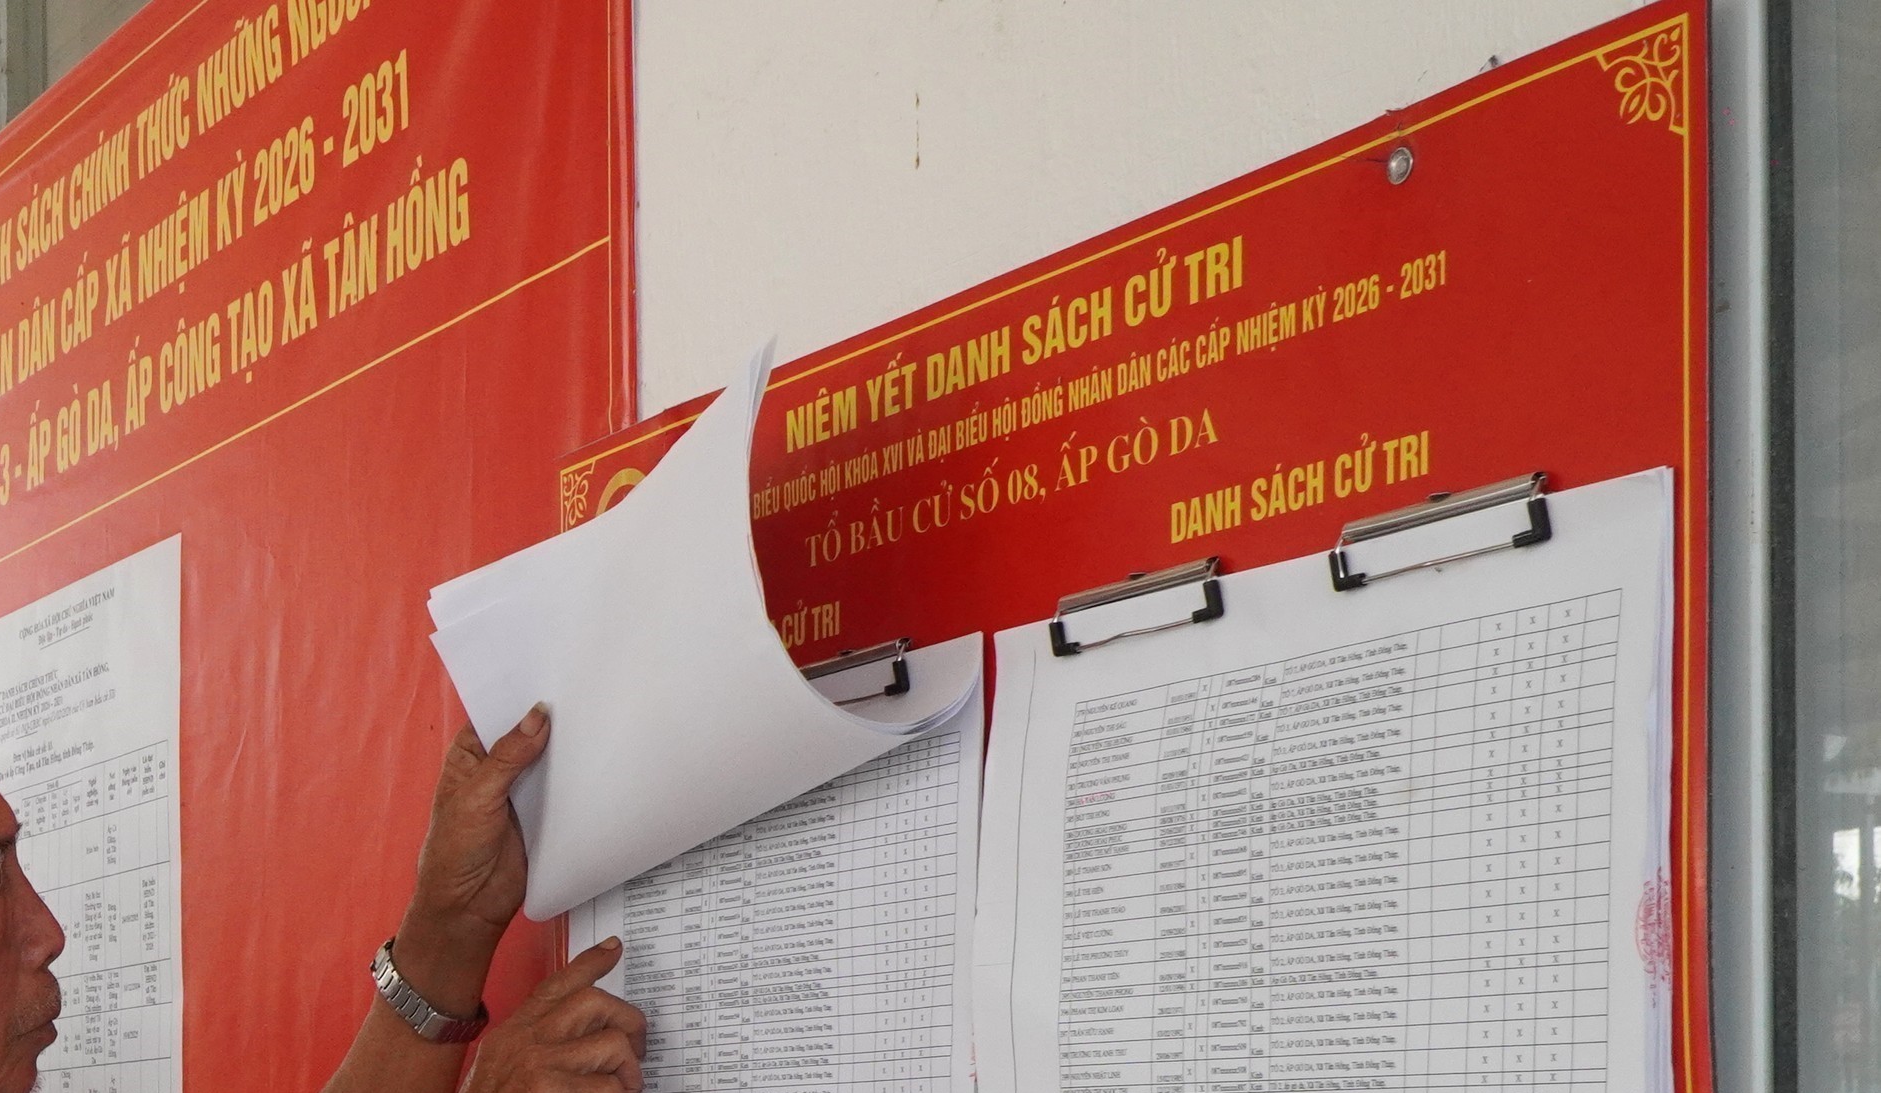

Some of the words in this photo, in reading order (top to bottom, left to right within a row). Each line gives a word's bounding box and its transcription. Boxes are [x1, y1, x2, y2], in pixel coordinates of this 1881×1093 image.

[15, 175, 65, 272] SÁCH
[70, 121, 130, 231] CHÍNH
[137, 73, 190, 180] THỨC
[197, 4, 283, 136] NHỮNG
[18, 295, 56, 384] DÂN
[60, 250, 99, 355] CẤP
[104, 230, 133, 327] XÃ
[137, 187, 209, 304] NHIỆM
[217, 149, 247, 252] KỲ
[253, 115, 315, 227] 2026
[323, 135, 334, 156] -
[342, 47, 409, 169] 2031
[0, 443, 10, 506] 3
[14, 463, 22, 479] -
[26, 399, 51, 492] ẤP
[56, 383, 81, 474] GÒ
[86, 379, 119, 452] DA,
[124, 335, 153, 436] ẤP
[159, 312, 221, 414] CÔNG
[227, 279, 274, 384] TẠO
[281, 237, 318, 347] XÃ
[323, 211, 378, 319] TÂN
[386, 154, 470, 285] HỒNG
[753, 476, 780, 521] BIỂU
[783, 464, 816, 511] QUỐC
[820, 460, 840, 500] HỘI
[844, 445, 878, 490] KHÓA
[882, 440, 903, 476] XVI
[906, 427, 925, 468] VÀ
[928, 425, 951, 464] ĐẠI
[955, 401, 988, 451] BIỂU
[992, 396, 1017, 441] HỘI
[1021, 377, 1064, 429] ĐỒNG
[1068, 365, 1112, 412] NHÂN
[1117, 352, 1151, 396] DÂN
[1156, 337, 1190, 383] CÁC
[1195, 316, 1230, 369] CẤP
[1236, 301, 1296, 352] NHIỆM
[1302, 285, 1326, 332] KỲ
[1332, 273, 1379, 323] 2026
[1386, 284, 1394, 293] -
[1400, 249, 1446, 299] 2031
[786, 386, 858, 453] NIÊM
[866, 352, 917, 423] YẾT
[926, 325, 1010, 401] DANH
[1022, 286, 1112, 366] SÁCH
[1124, 247, 1176, 327] CỬ
[1184, 234, 1243, 305] TRI
[805, 509, 841, 567] TỔ
[849, 496, 904, 555] BẦU
[912, 479, 954, 534] CỬ
[959, 457, 1000, 521] SỐ
[1007, 463, 1046, 506] 08,
[1054, 431, 1098, 492] ẤP
[1106, 416, 1158, 474] GÒ
[1169, 407, 1218, 457] DA
[1171, 484, 1241, 544] DANH
[1250, 460, 1324, 522] SÁCH
[1334, 431, 1376, 498] CỬ
[1382, 430, 1429, 486] TRI
[782, 600, 807, 649] CỬ
[811, 601, 840, 641] TRI
